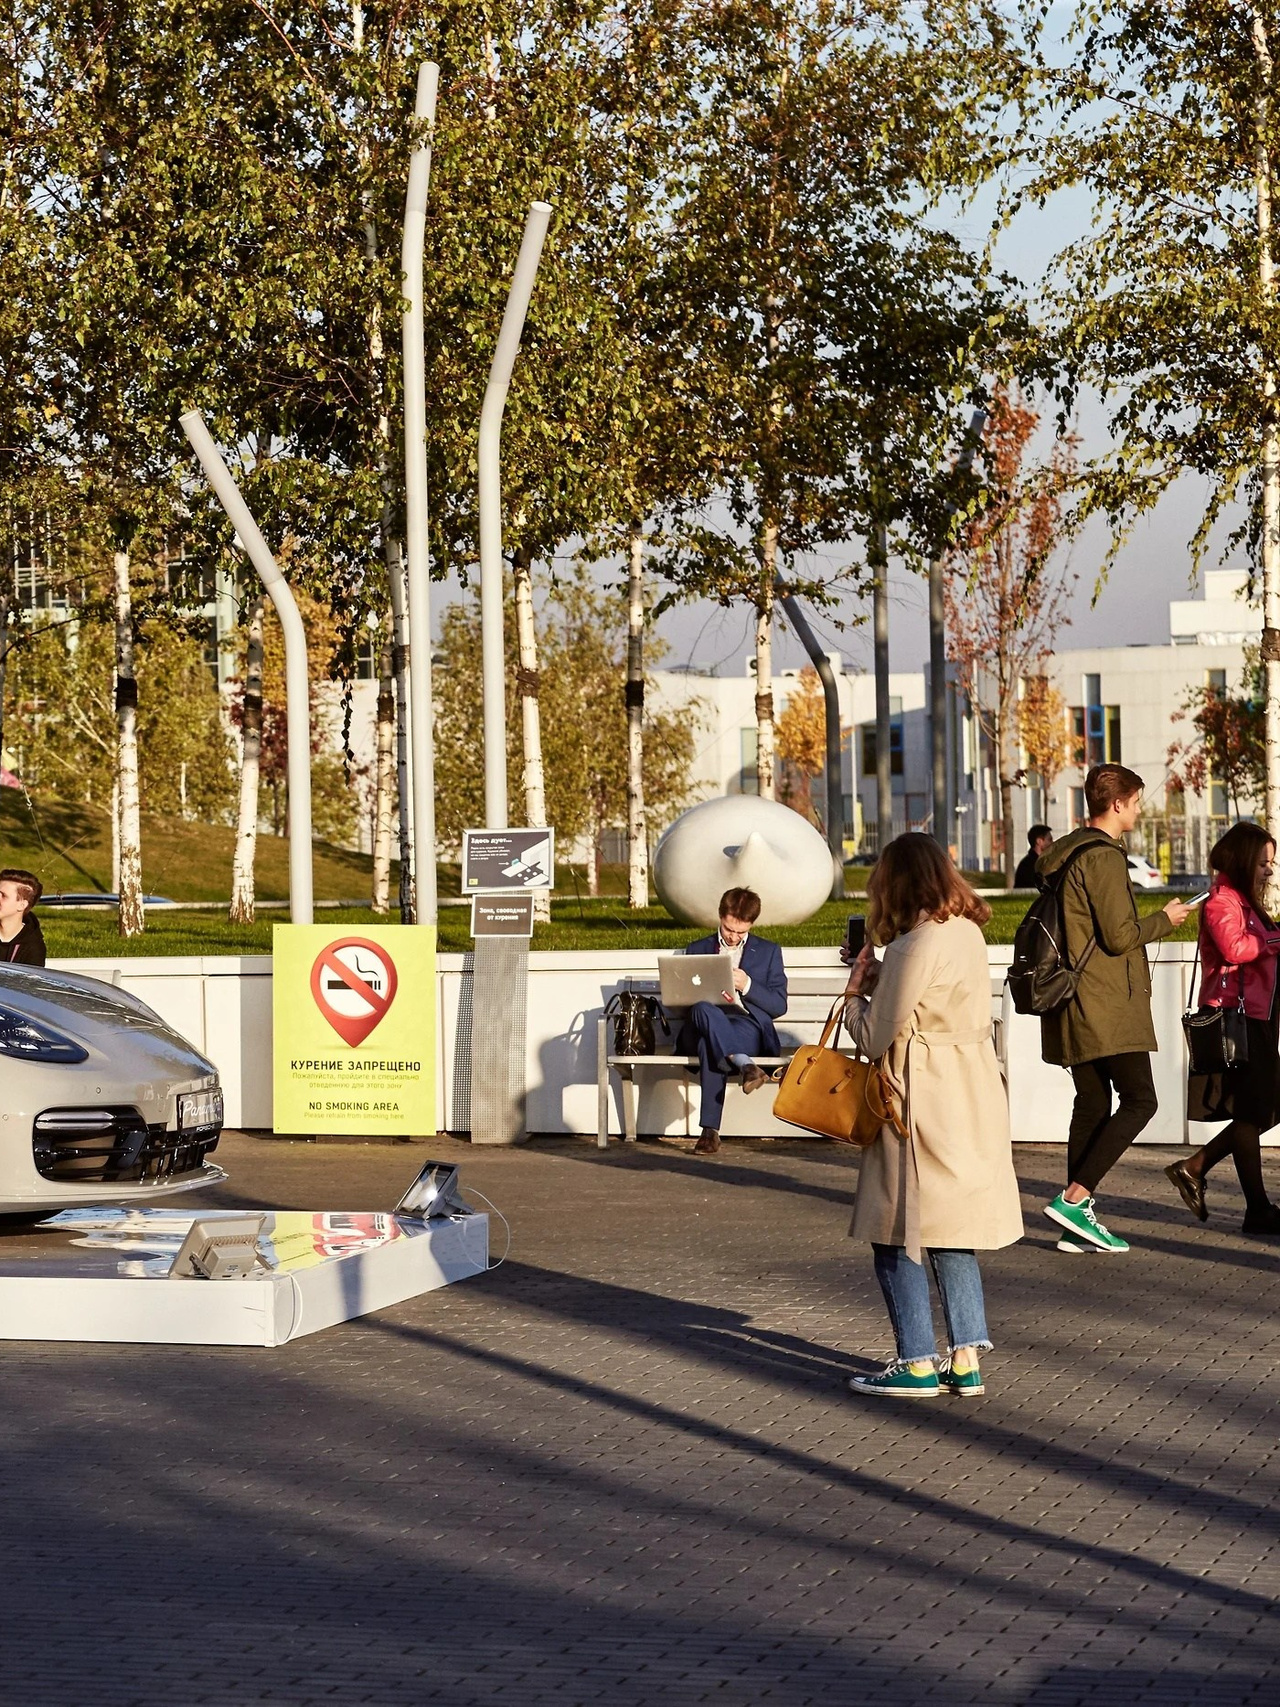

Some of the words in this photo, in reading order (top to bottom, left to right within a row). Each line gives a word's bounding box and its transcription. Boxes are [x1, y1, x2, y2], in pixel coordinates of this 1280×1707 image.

[291, 1060, 343, 1070] КУРЕНИЕ
[348, 1060, 421, 1072] ЗАПРЕЩЕНО
[338, 1072, 370, 1080] пройдите
[377, 1073, 420, 1081] специально
[308, 1101, 322, 1110] NO
[325, 1102, 370, 1111] SMOKING
[373, 1102, 400, 1111] AREA
[363, 1113, 389, 1121] smoking
